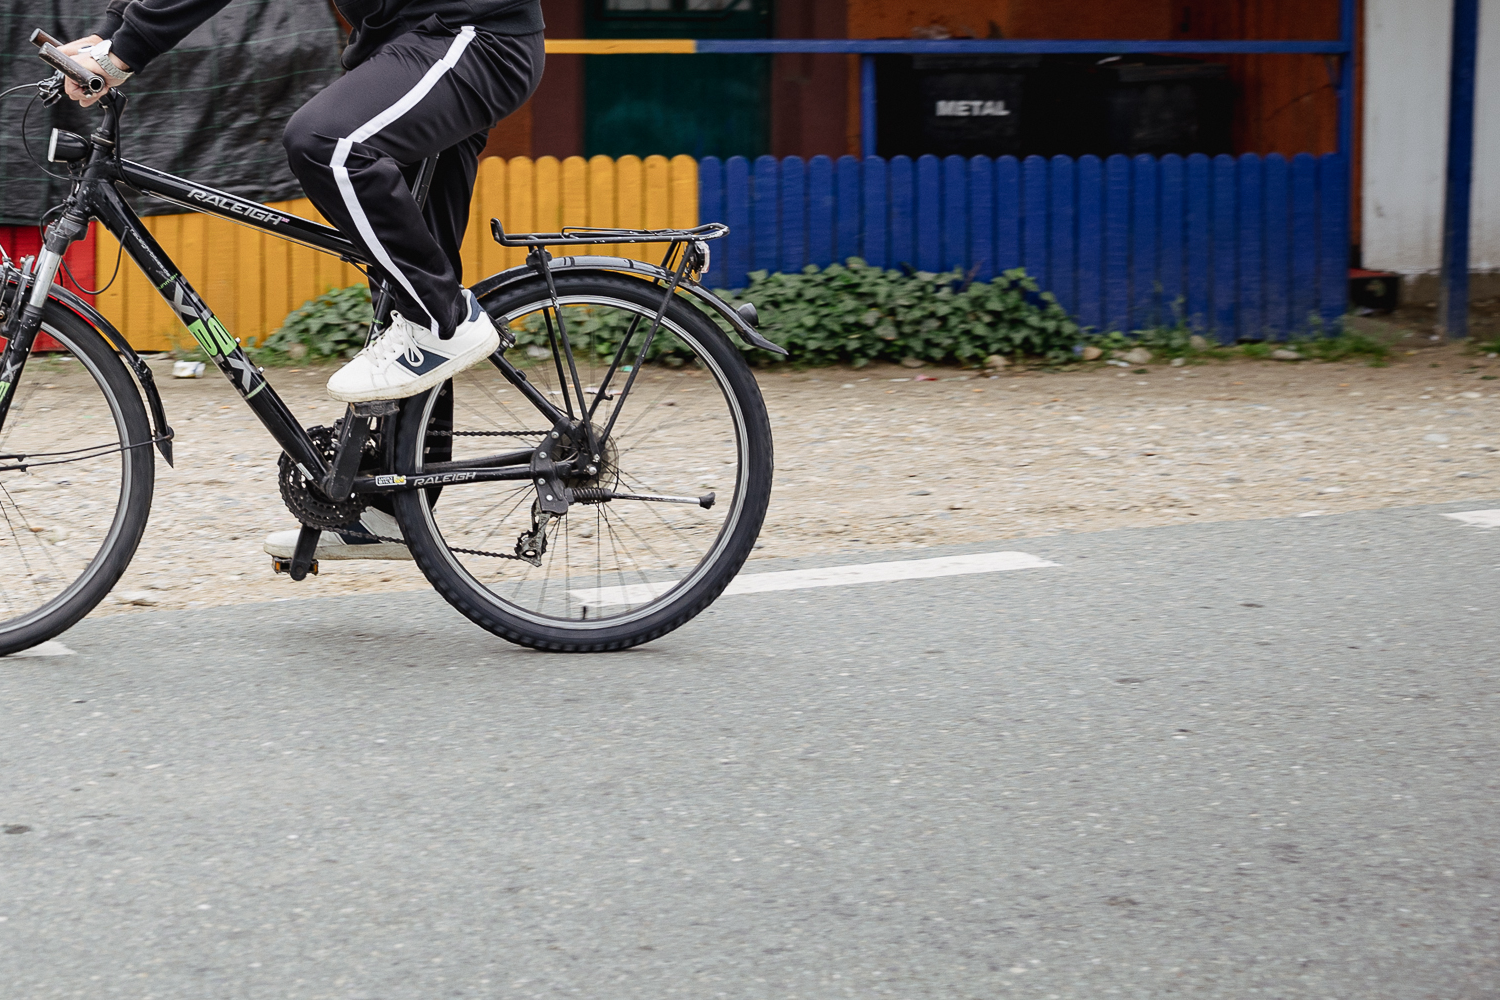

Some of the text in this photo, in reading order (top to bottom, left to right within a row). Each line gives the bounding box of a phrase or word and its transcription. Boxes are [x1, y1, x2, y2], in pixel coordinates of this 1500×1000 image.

[936, 100, 1010, 116] METAL
[187, 188, 282, 225] RALEIGH
[413, 472, 477, 487] RALEIGH
